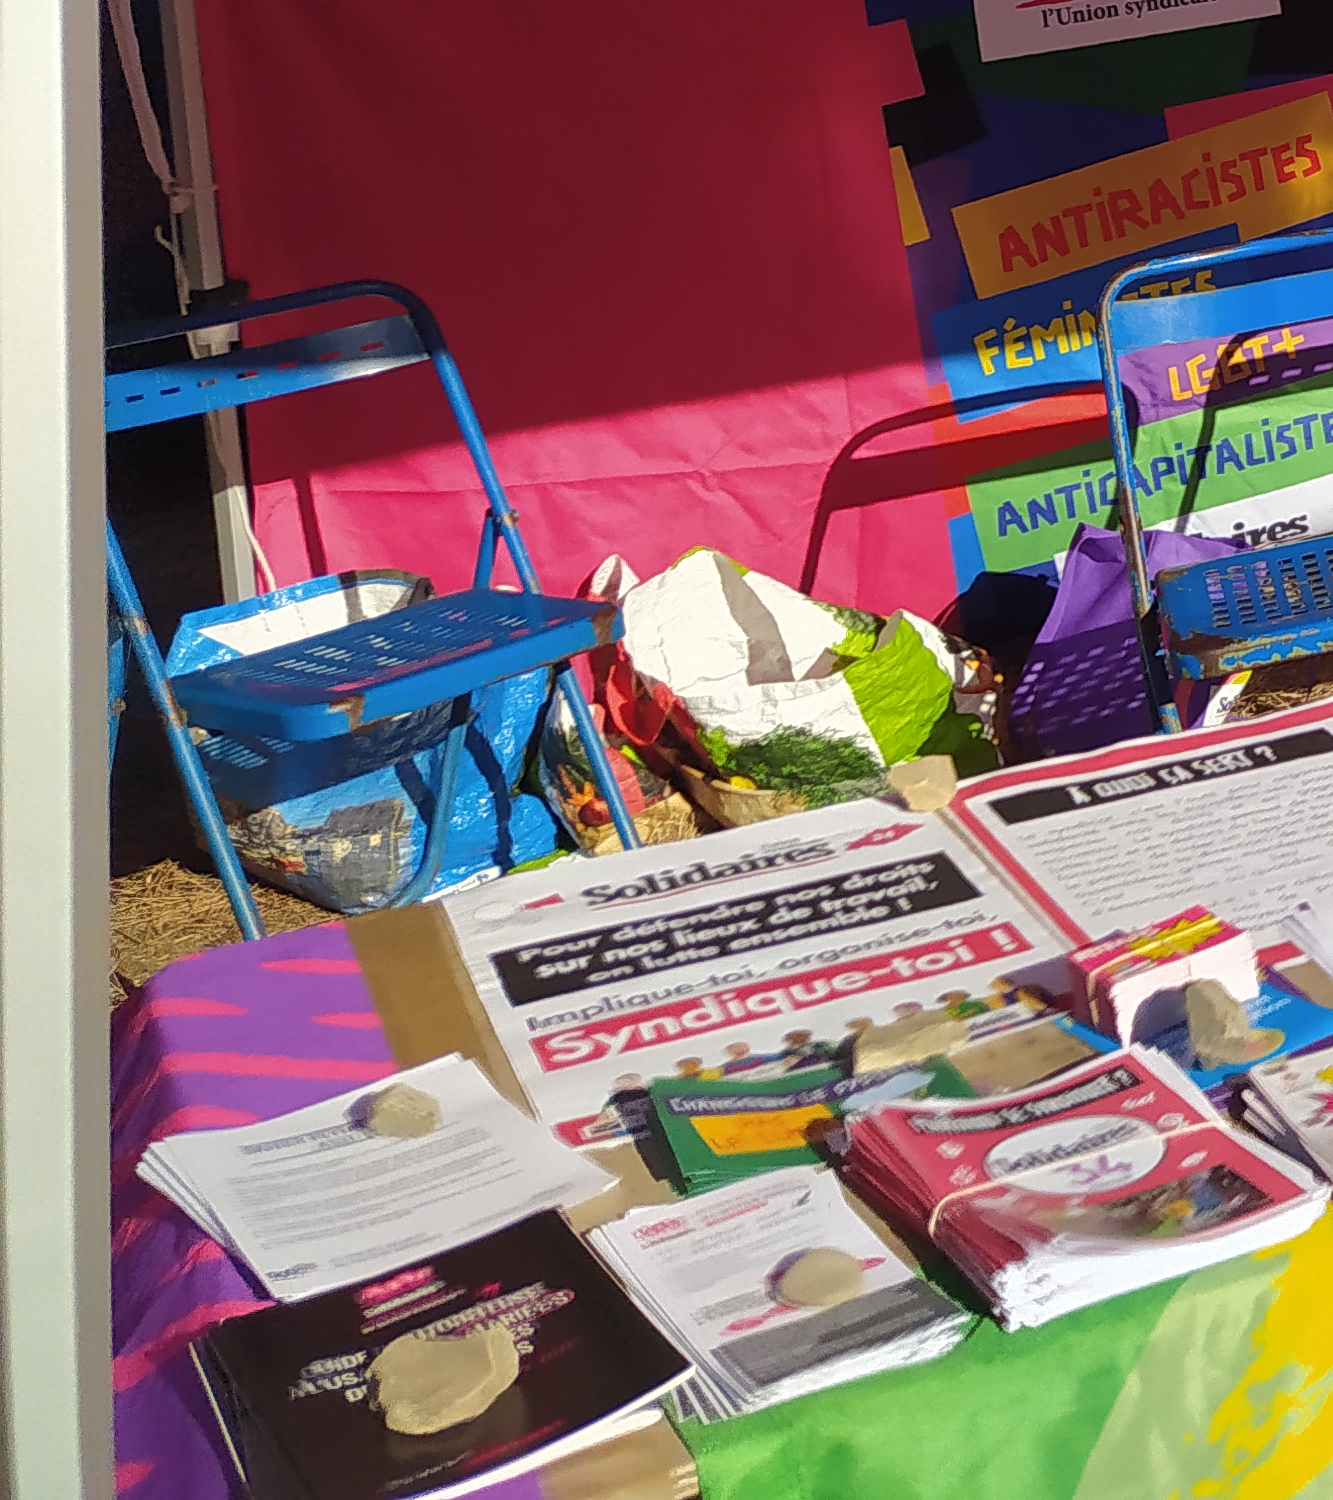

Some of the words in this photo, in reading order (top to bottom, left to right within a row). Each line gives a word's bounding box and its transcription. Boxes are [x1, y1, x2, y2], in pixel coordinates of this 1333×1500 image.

[1041, 1, 1117, 29] l'Union
[1168, 328, 1306, 402] LGBT+
[581, 842, 836, 907] Solidaires
[516, 925, 606, 965] Pour
[609, 894, 773, 943] défendre
[775, 883, 836, 906] nos
[842, 859, 937, 892] droits
[533, 952, 591, 979] sur
[602, 936, 667, 965] nos
[674, 913, 764, 949] lieux
[769, 905, 805, 926] de
[643, 944, 721, 973] lutte
[728, 907, 891, 953] ensemble
[527, 964, 769, 1033] Implique-toi,
[777, 909, 1001, 971] organise-toi,
[546, 933, 979, 1067] Syndique-toi
[990, 928, 1021, 952] !
